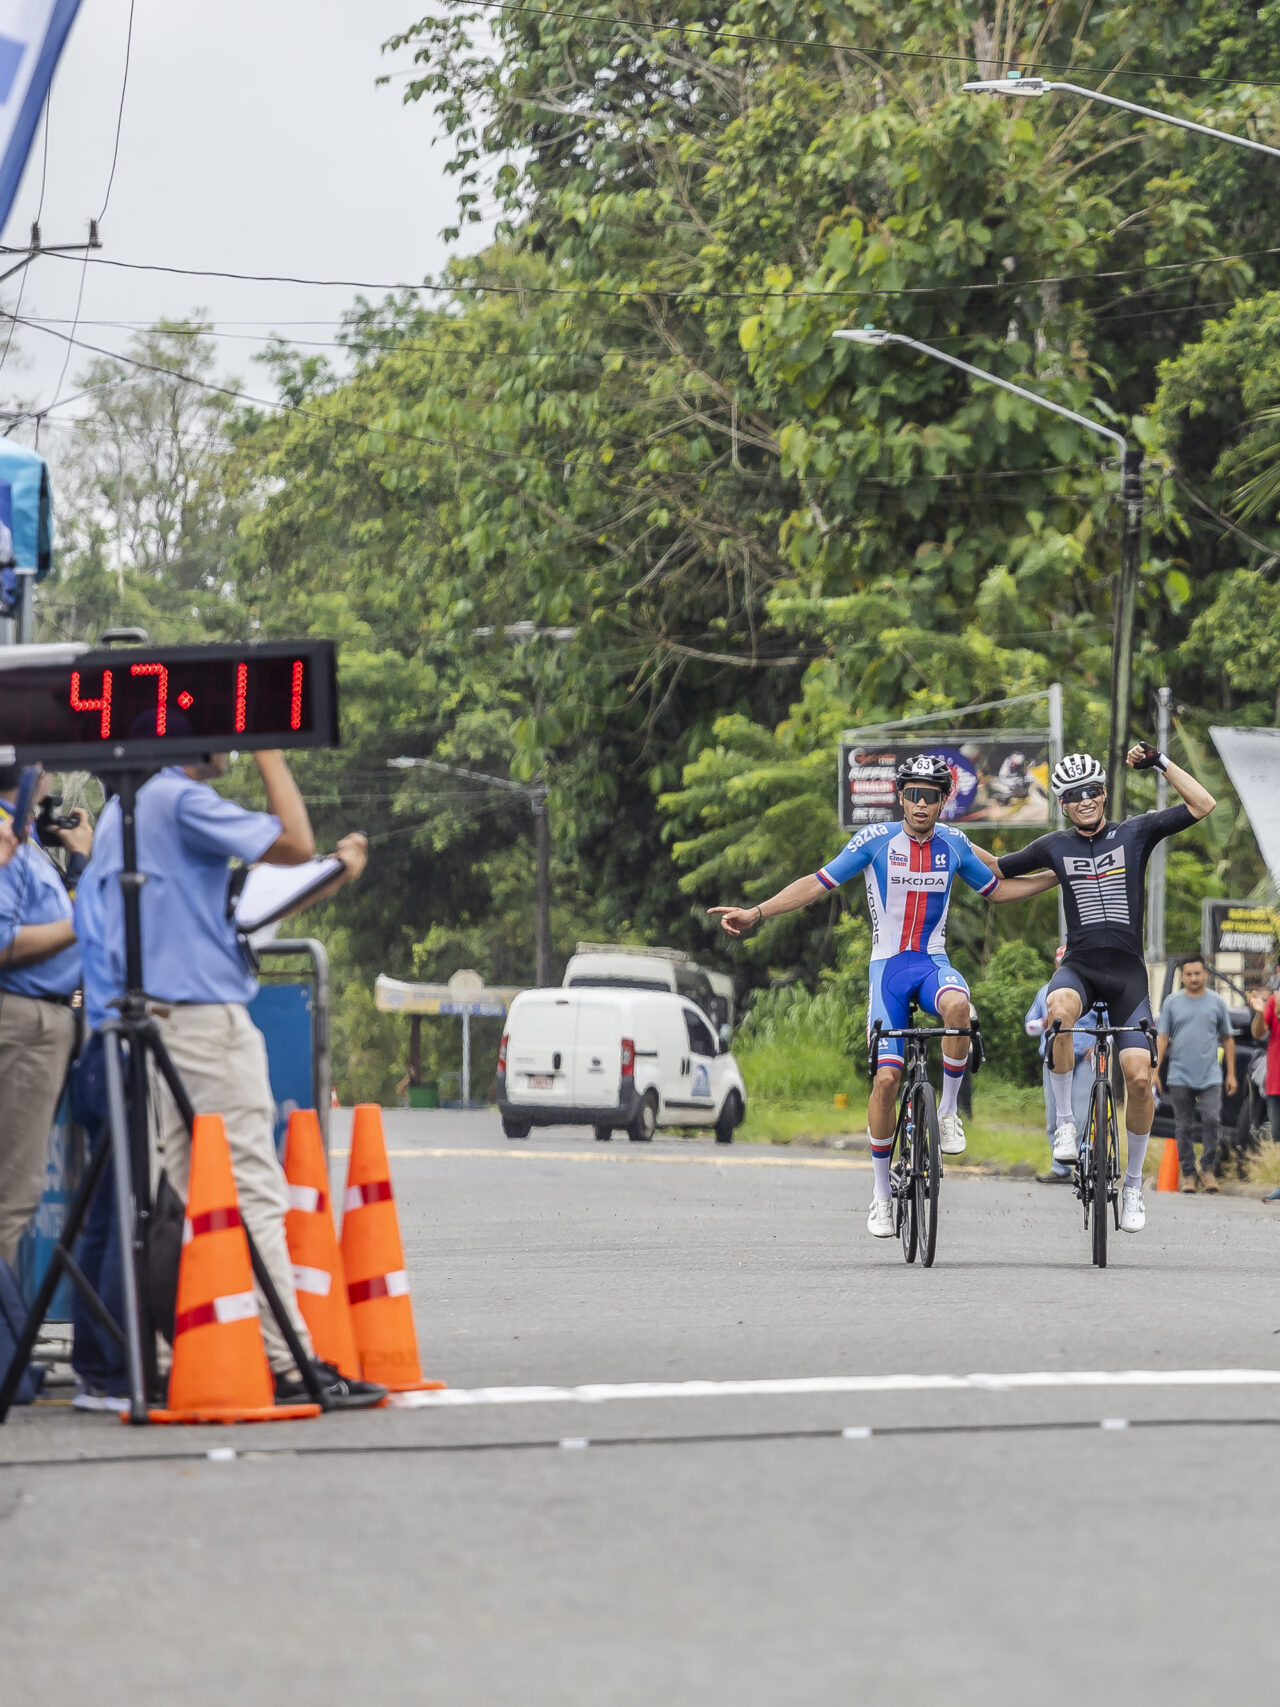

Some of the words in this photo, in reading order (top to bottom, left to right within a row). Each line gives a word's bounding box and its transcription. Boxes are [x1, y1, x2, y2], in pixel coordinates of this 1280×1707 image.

[916, 759, 931, 770] 63
[1068, 764, 1083, 778] 35
[1072, 852, 1116, 872] 24
